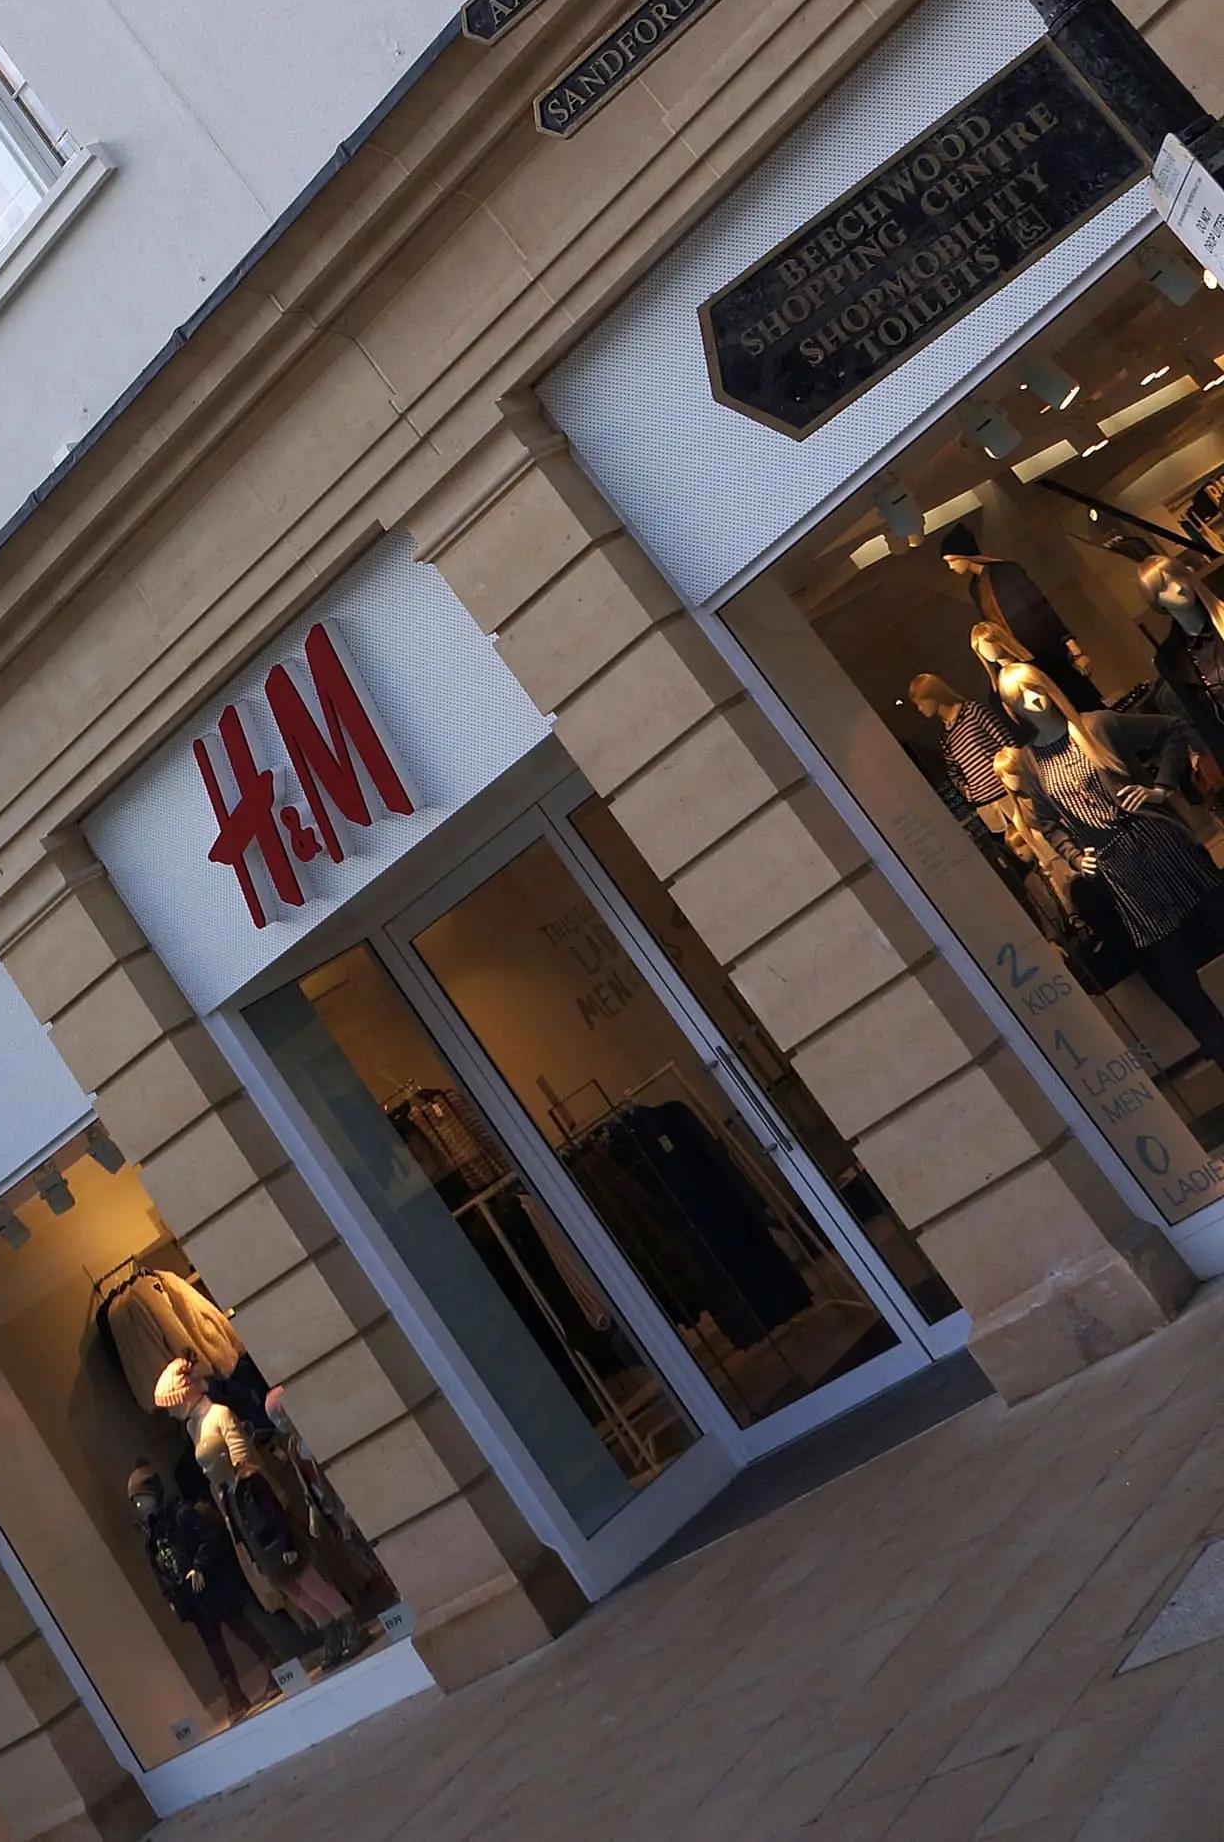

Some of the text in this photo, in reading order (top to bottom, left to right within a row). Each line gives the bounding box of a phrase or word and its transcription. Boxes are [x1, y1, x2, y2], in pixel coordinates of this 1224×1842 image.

[740, 218, 909, 358] SHOPPING
[920, 101, 1059, 216] CENTRE
[775, 114, 992, 292] BEECHWOOD
[798, 161, 1049, 366] SHOPMOBILITY
[854, 244, 1001, 364] TOILETS
[193, 624, 416, 929] H&M
[996, 942, 1040, 990] 2
[1022, 974, 1073, 1016] KIDS
[1053, 1027, 1090, 1070] 1
[1100, 1080, 1155, 1125] MEN
[1161, 1158, 1224, 1207] LADIE
